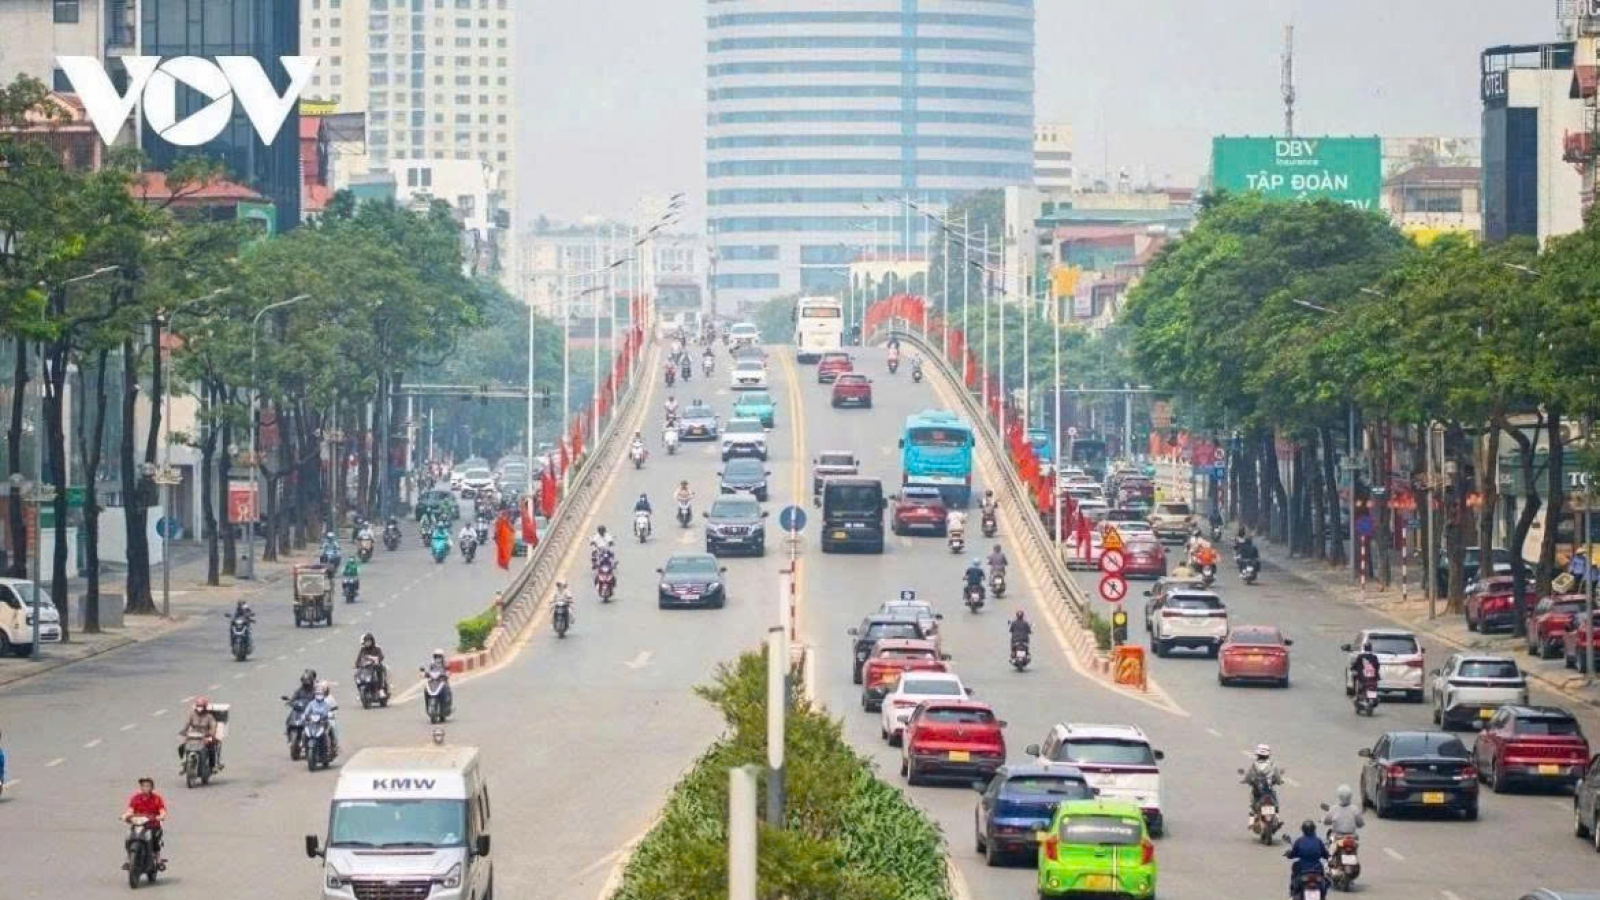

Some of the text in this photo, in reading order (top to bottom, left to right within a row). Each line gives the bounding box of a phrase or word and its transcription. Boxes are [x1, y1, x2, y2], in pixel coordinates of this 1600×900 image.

[1276, 140, 1317, 156] DBV
[1246, 170, 1348, 193] TẬP ĐOÀN
[372, 778, 436, 789] KMW
